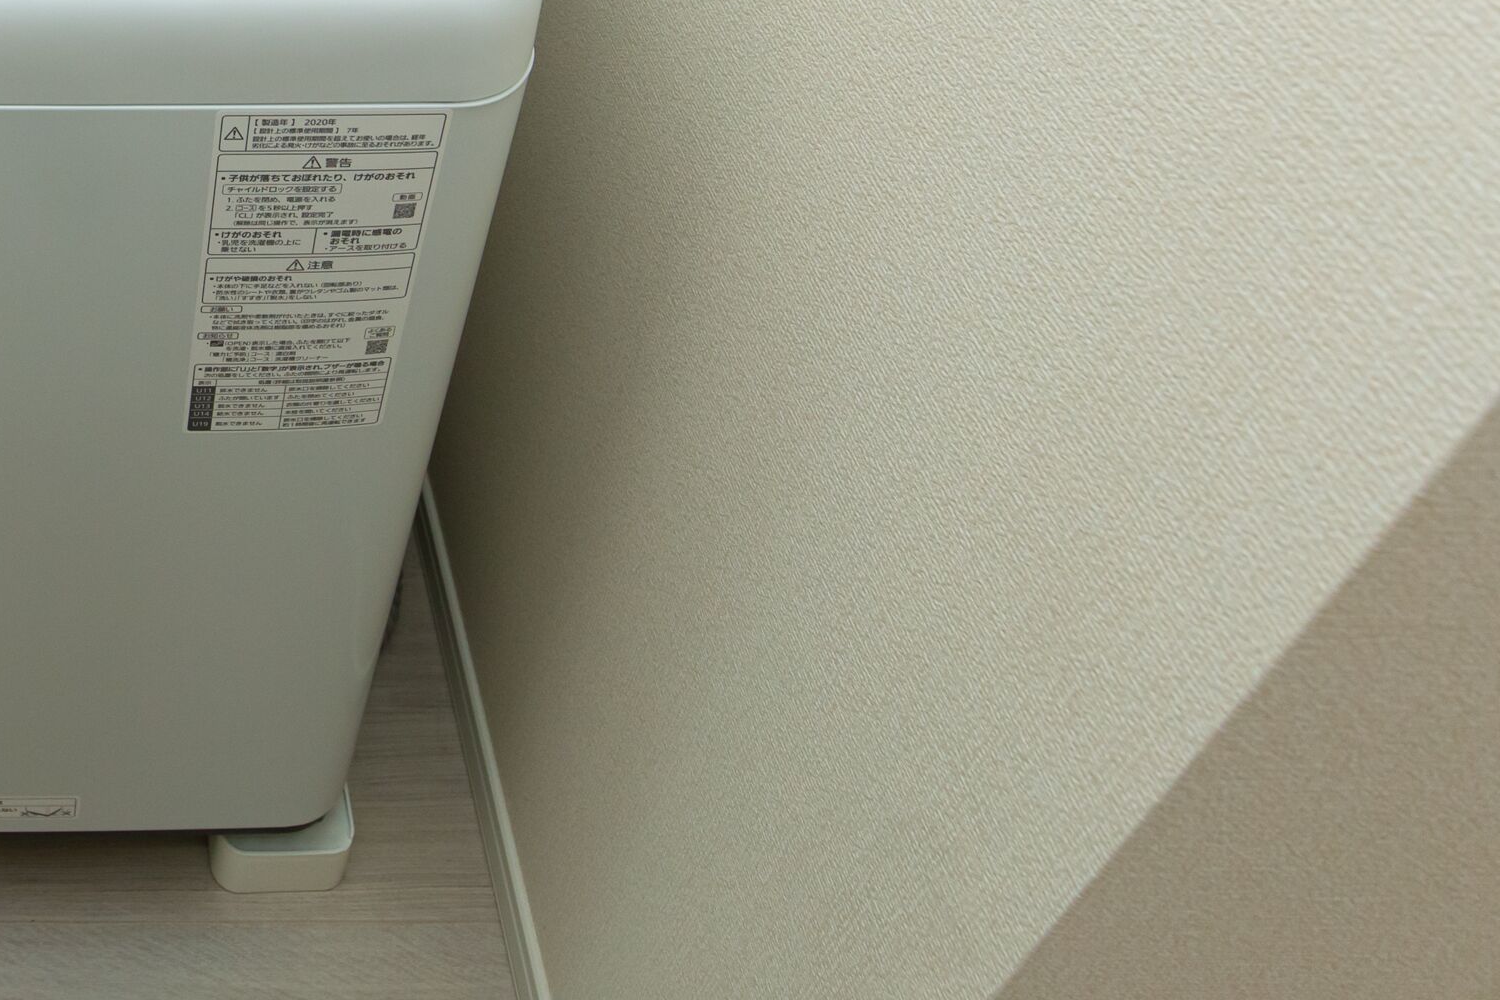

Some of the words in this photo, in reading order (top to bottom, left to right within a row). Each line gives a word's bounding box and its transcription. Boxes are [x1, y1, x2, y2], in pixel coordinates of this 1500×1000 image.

[304, 118, 337, 126] 2020年
[325, 157, 353, 168] 警告
[227, 185, 338, 194] チャイルドロックを設定する
[221, 231, 283, 239] けがのおそれ
[329, 237, 360, 245] おそれ
[307, 260, 334, 270] 注意
